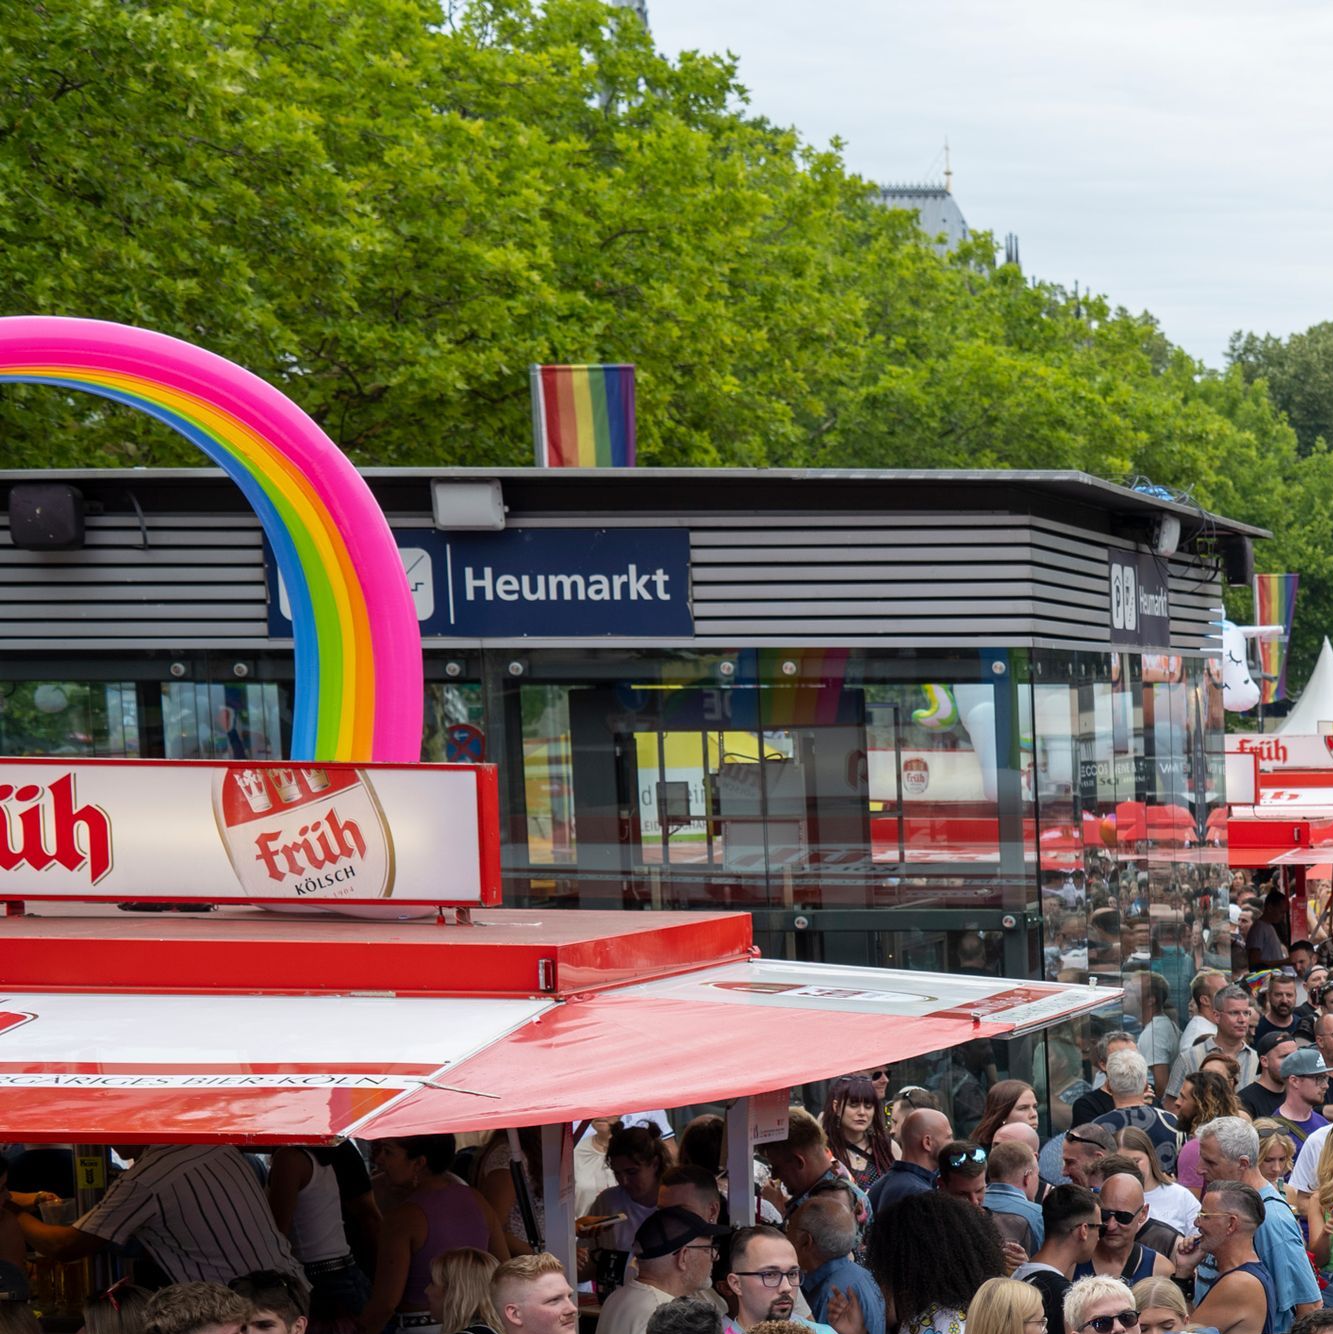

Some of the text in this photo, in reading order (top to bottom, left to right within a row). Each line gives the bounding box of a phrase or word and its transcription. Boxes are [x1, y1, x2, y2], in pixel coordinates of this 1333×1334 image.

[465, 564, 671, 601] Heumarkt
[1139, 585, 1168, 617] Heumarkt
[294, 866, 357, 897] KÖLSCH
